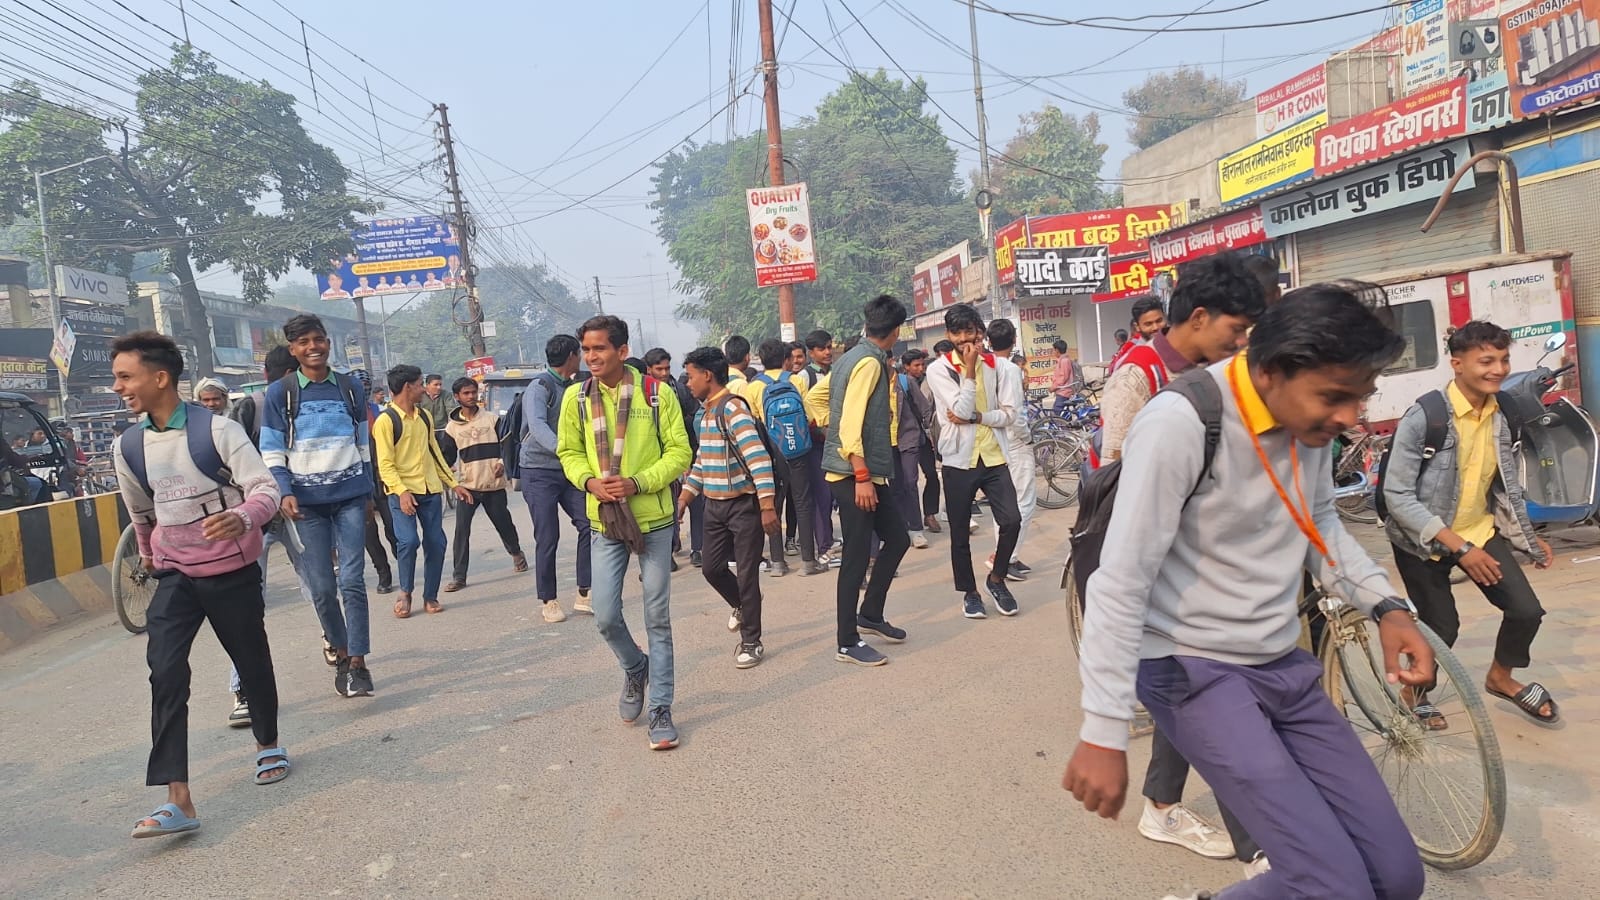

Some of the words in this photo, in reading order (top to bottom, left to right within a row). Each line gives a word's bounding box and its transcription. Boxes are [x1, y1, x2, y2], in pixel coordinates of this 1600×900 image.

[1507, 9, 1537, 31] GSTIN:
[1405, 22, 1425, 57] 0%
[1277, 105, 1285, 122] H
[1287, 102, 1294, 118] R
[1472, 85, 1512, 124] का
[1320, 125, 1379, 168] प्रियंका
[1382, 86, 1462, 147] स्टेशनर्स
[751, 187, 801, 206] QUALITY
[1269, 188, 1339, 225] कालेज
[1344, 173, 1390, 213] बुक
[1395, 148, 1457, 192] डिपो
[765, 206, 777, 215] Dry
[779, 205, 798, 213] Fruits
[1081, 223, 1120, 247] बक
[1126, 210, 1171, 241] डिपो
[1016, 251, 1062, 283] शादी
[1066, 247, 1107, 281] कार्ड
[1151, 236, 1188, 265] प्रियंका
[69, 272, 108, 295] vivo
[1111, 263, 1149, 292] ादी
[1020, 303, 1045, 321] शादी
[1047, 301, 1072, 319] कार्ड
[0, 361, 25, 373] स्तक
[783, 422, 796, 451] safari
